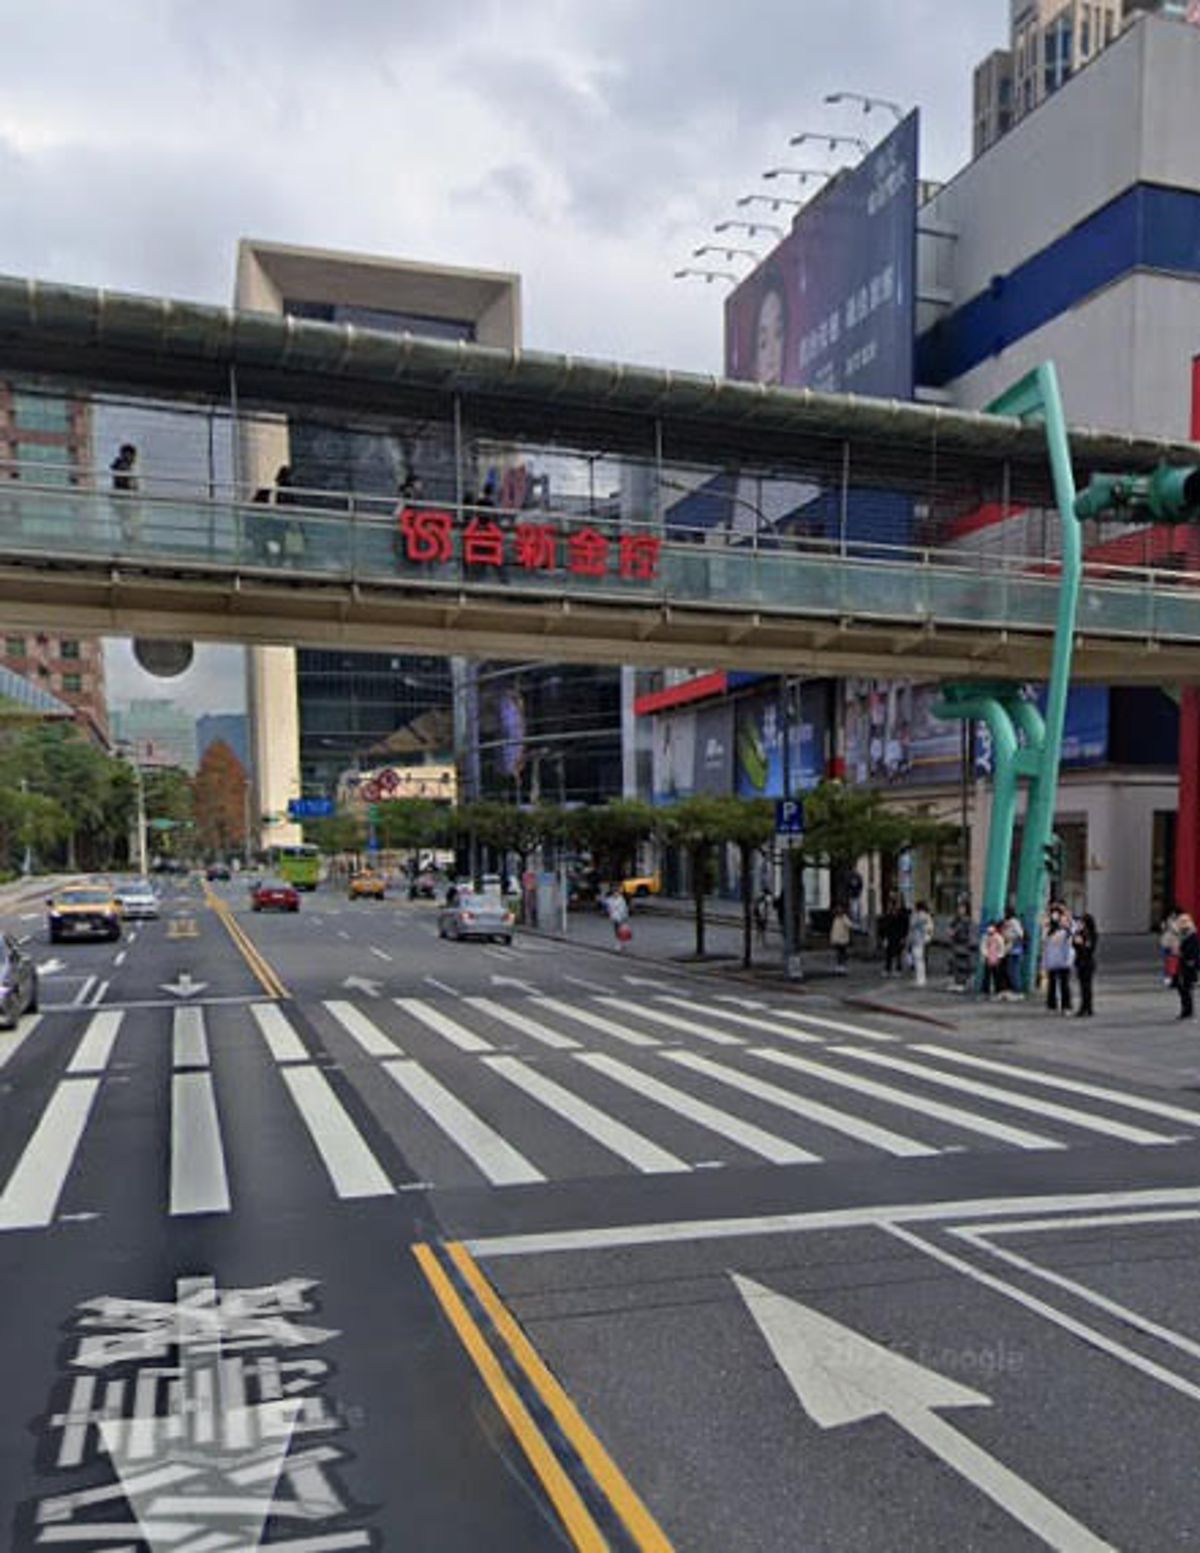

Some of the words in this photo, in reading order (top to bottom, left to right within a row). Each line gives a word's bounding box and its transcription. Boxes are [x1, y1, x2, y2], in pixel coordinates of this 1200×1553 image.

[464, 517, 661, 580] 台新金控
[783, 801, 798, 822] P
